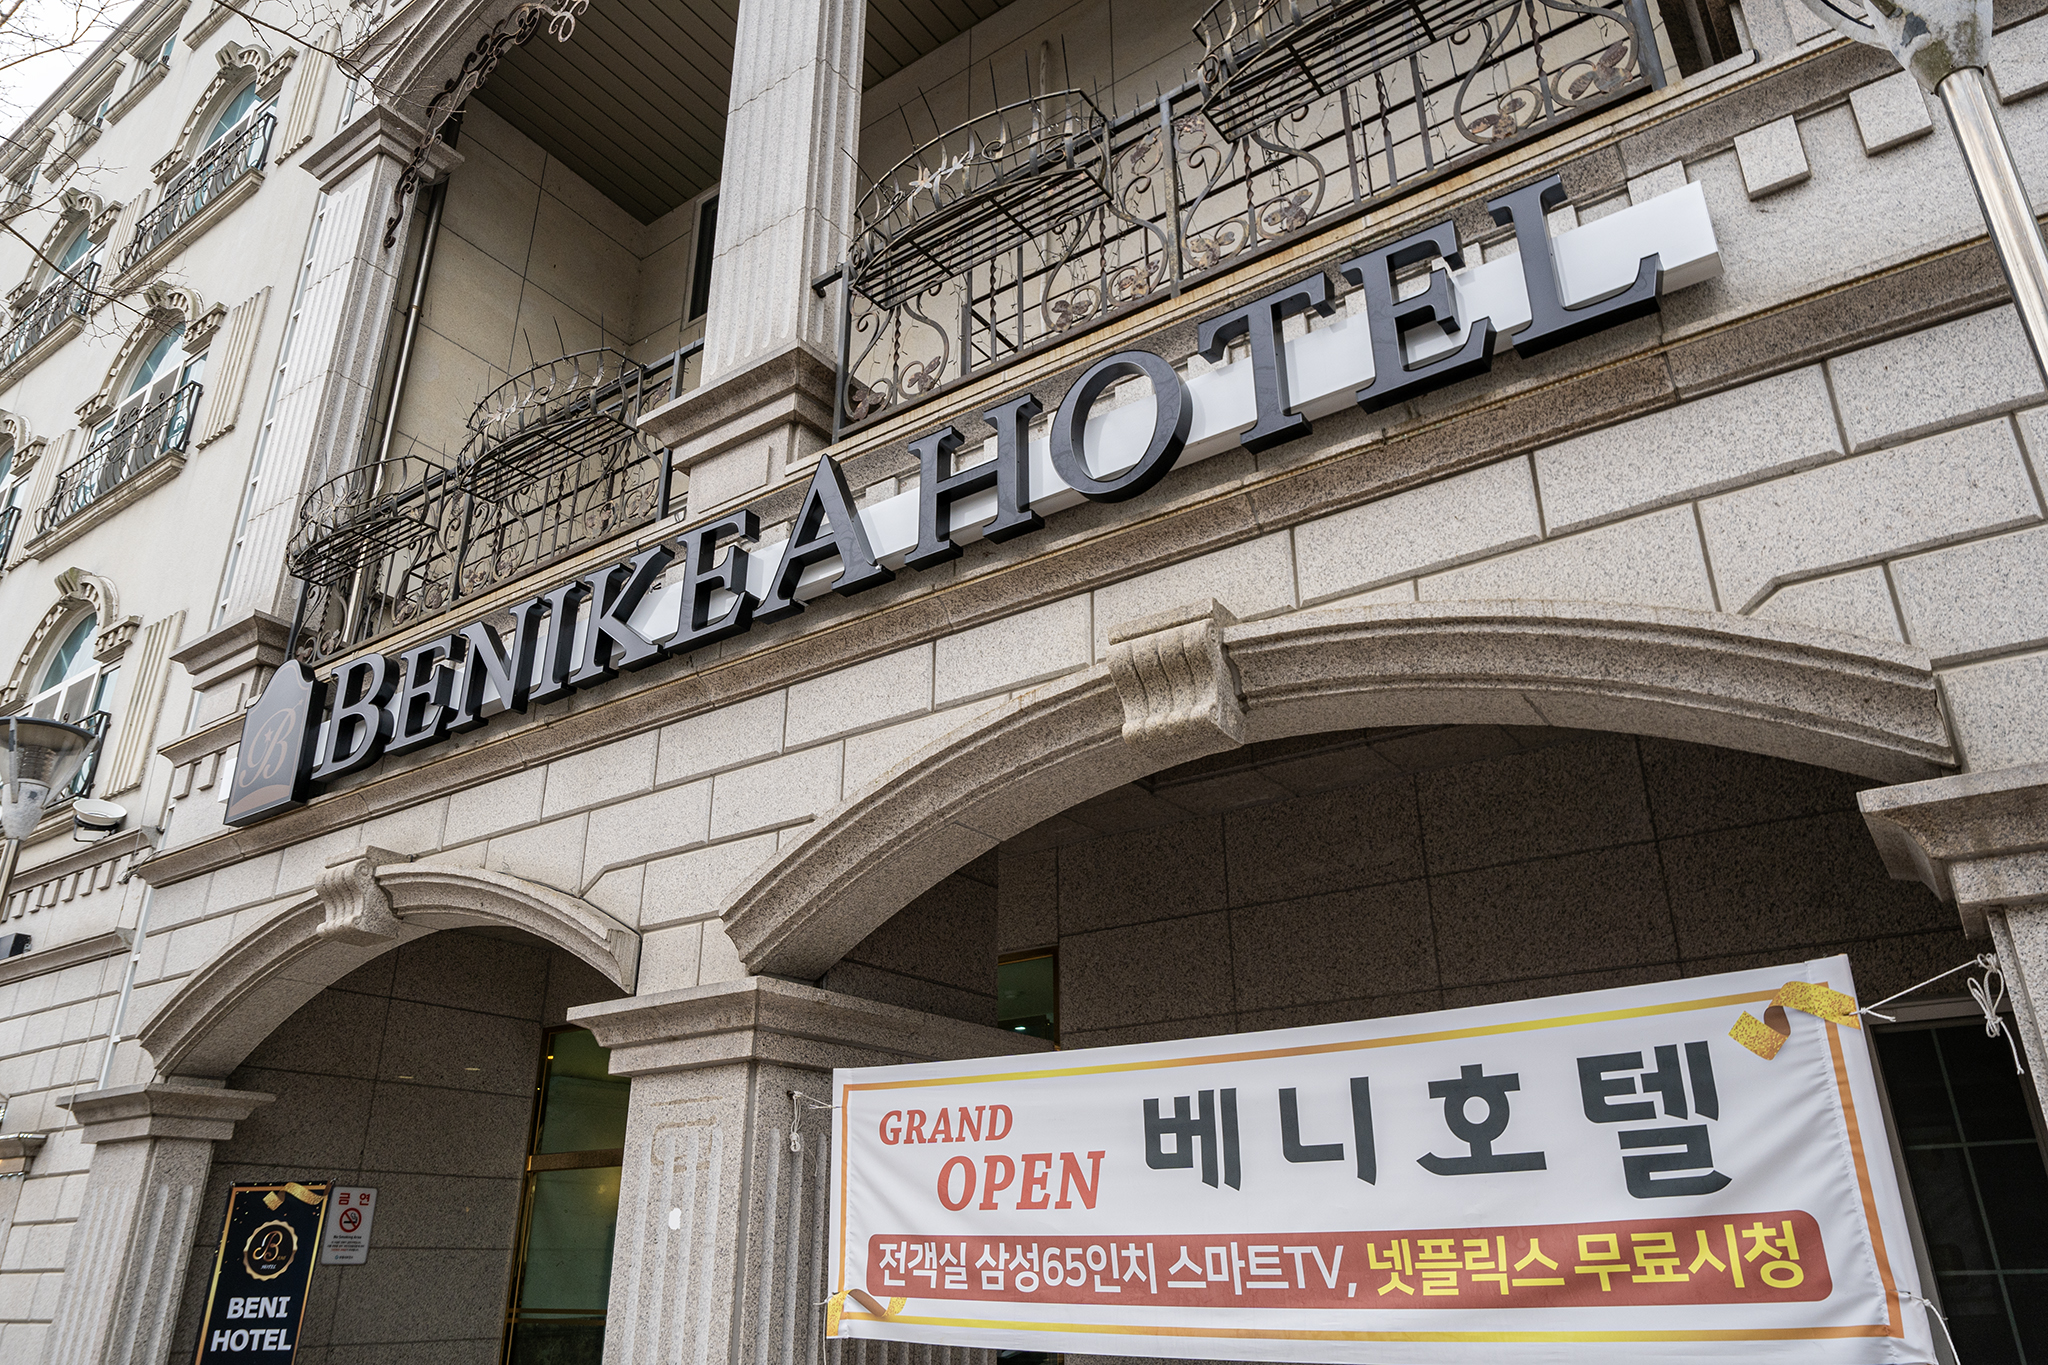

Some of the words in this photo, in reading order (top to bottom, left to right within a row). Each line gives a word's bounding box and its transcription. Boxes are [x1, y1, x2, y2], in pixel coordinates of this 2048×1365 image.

[879, 1104, 1013, 1146] GRAND
[937, 1150, 1106, 1212] OPEN
[878, 1241, 968, 1291] 전객실
[974, 1242, 1158, 1295] 삼성65인치
[1166, 1241, 1358, 1298] 스마트TV,
[1366, 1235, 1566, 1297] 넷플릭스
[1574, 1220, 1805, 1292] 무료시청
[226, 1296, 291, 1319] BENI
[210, 1328, 292, 1352] HOTEL
